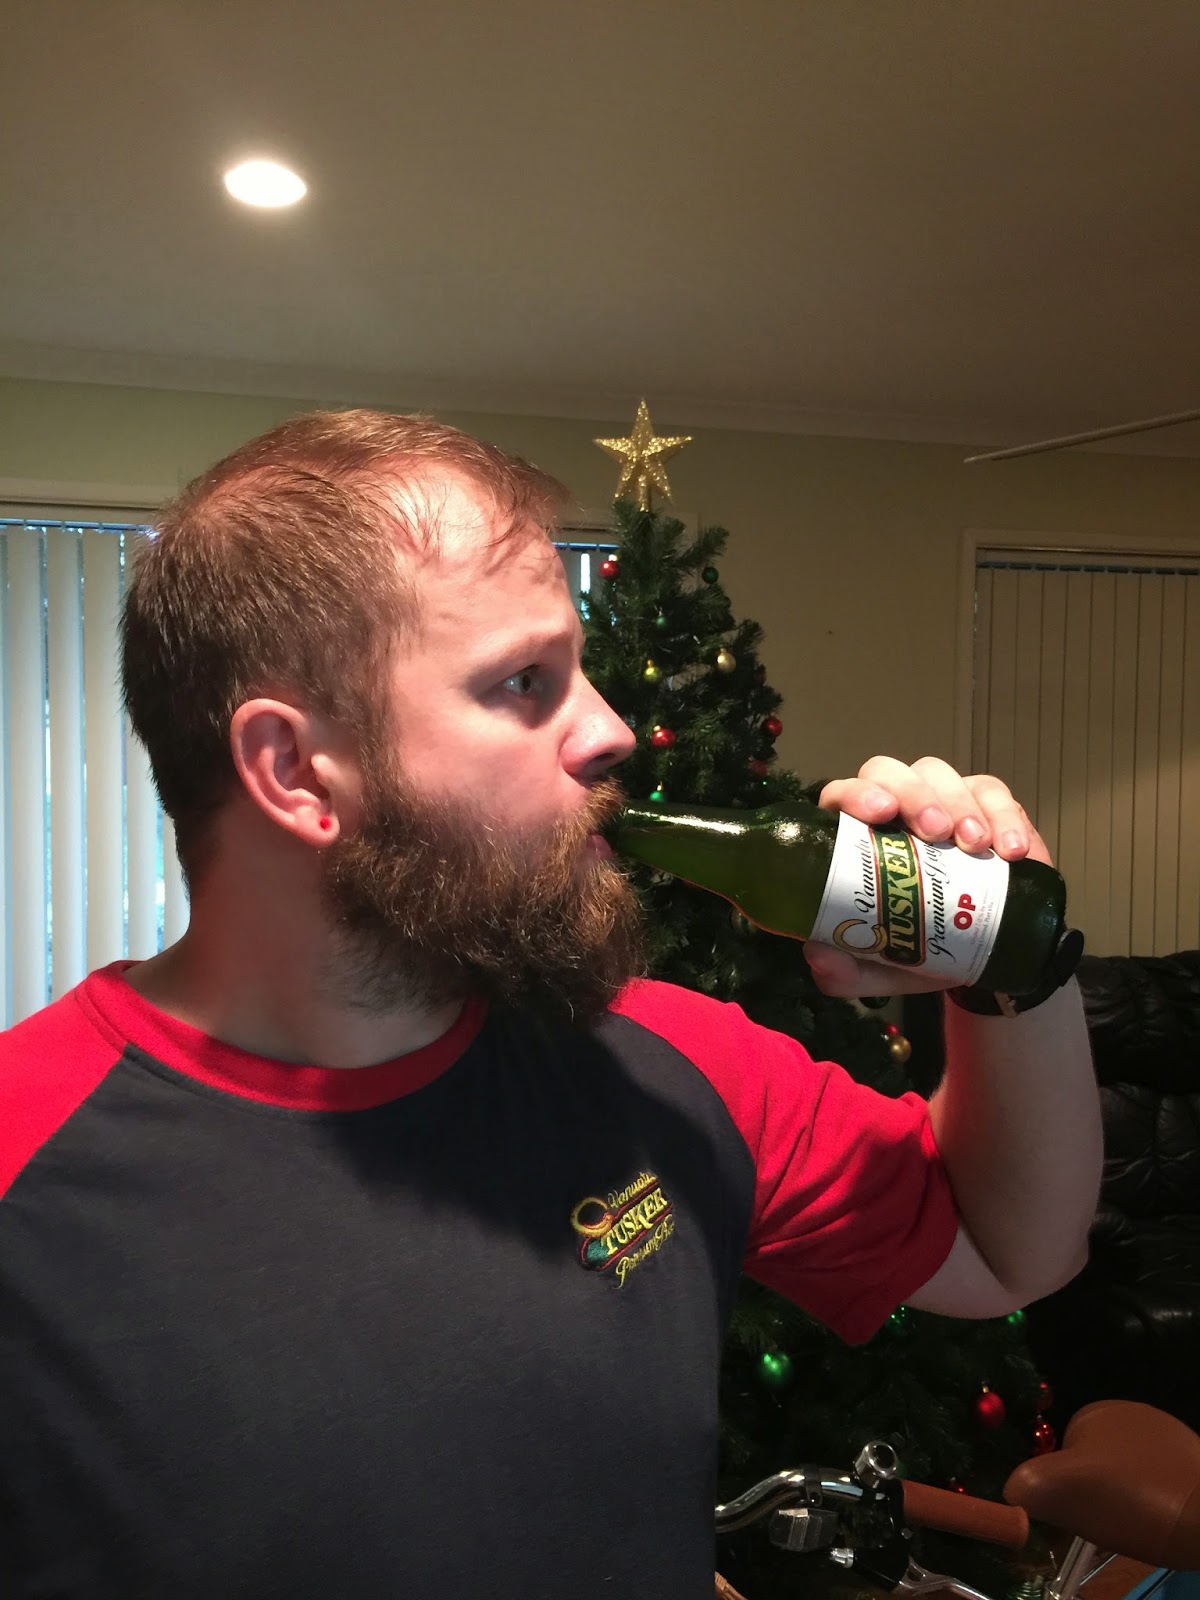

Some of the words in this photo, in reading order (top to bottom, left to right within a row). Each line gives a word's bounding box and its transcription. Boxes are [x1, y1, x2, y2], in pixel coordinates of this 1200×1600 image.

[854, 839, 876, 913] Vanuatu
[881, 836, 919, 951] TUSKER
[923, 843, 950, 884] Lag
[925, 877, 956, 965] Premium
[953, 893, 976, 931] OP
[600, 1187, 668, 1256] TUSKER
